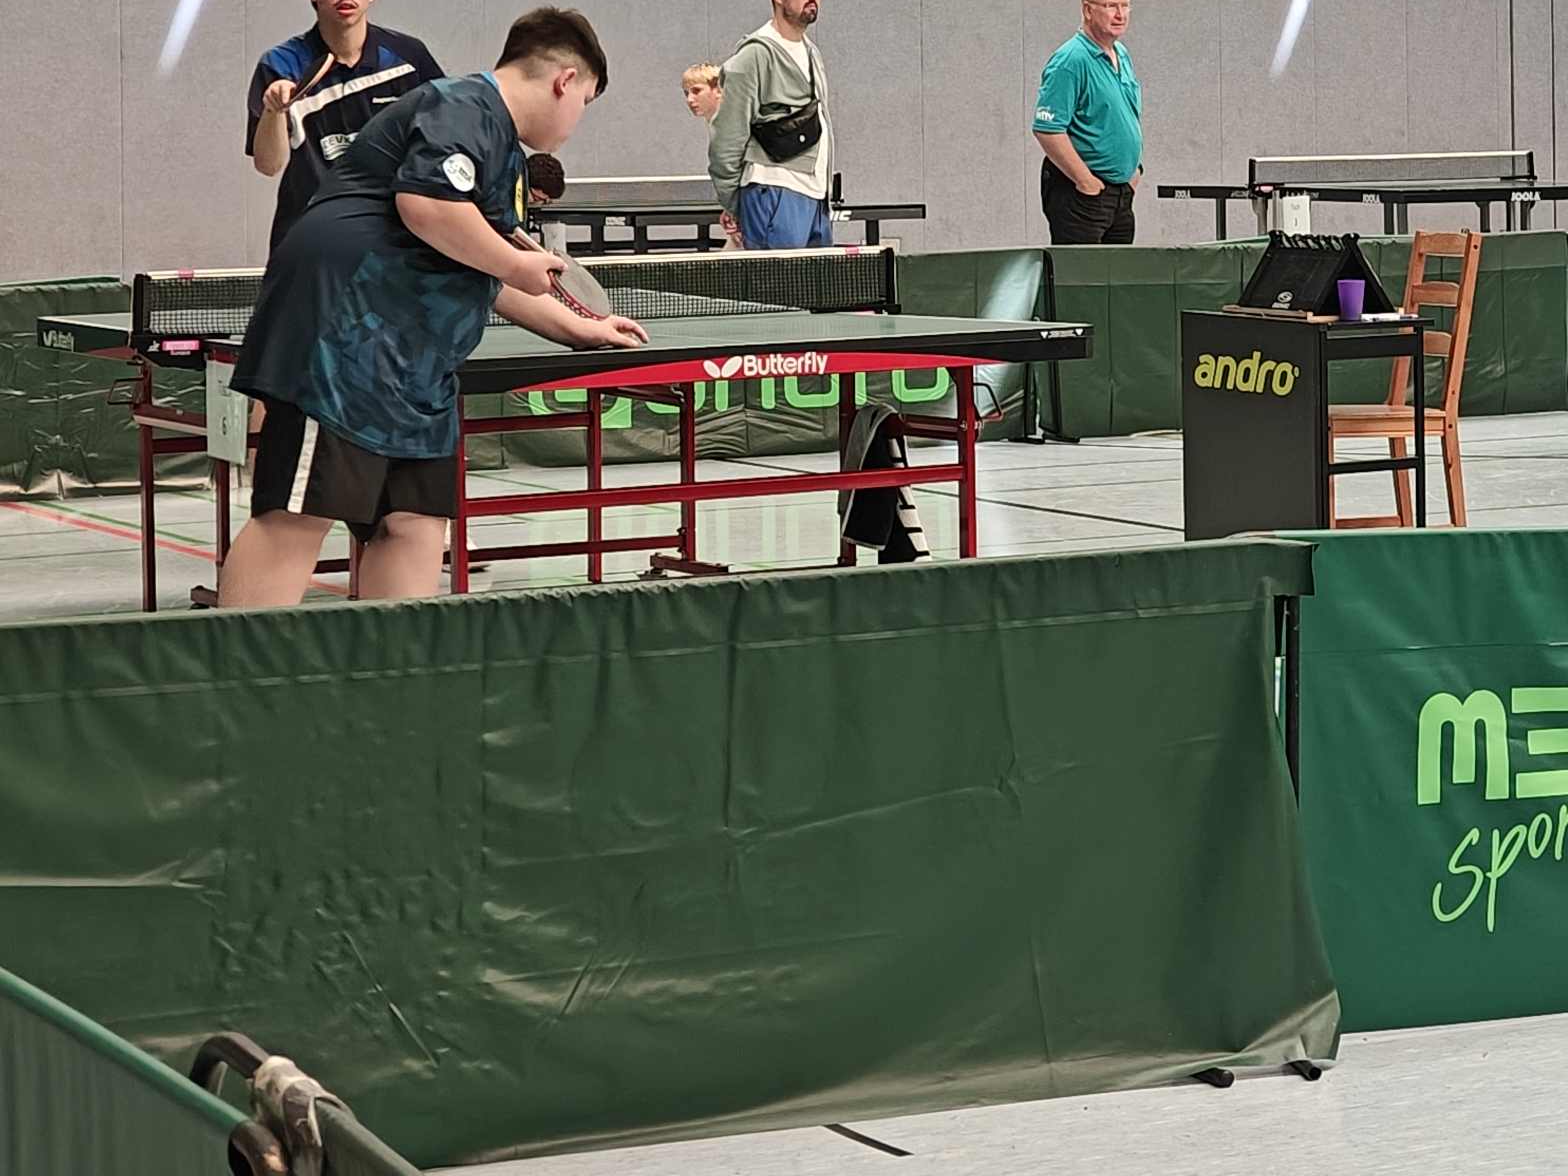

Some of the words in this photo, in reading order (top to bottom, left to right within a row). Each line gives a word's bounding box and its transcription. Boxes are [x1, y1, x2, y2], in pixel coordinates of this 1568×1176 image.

[1510, 191, 1542, 202] JOOLA
[743, 351, 828, 377] Butterfly
[1194, 351, 1295, 397] andro
